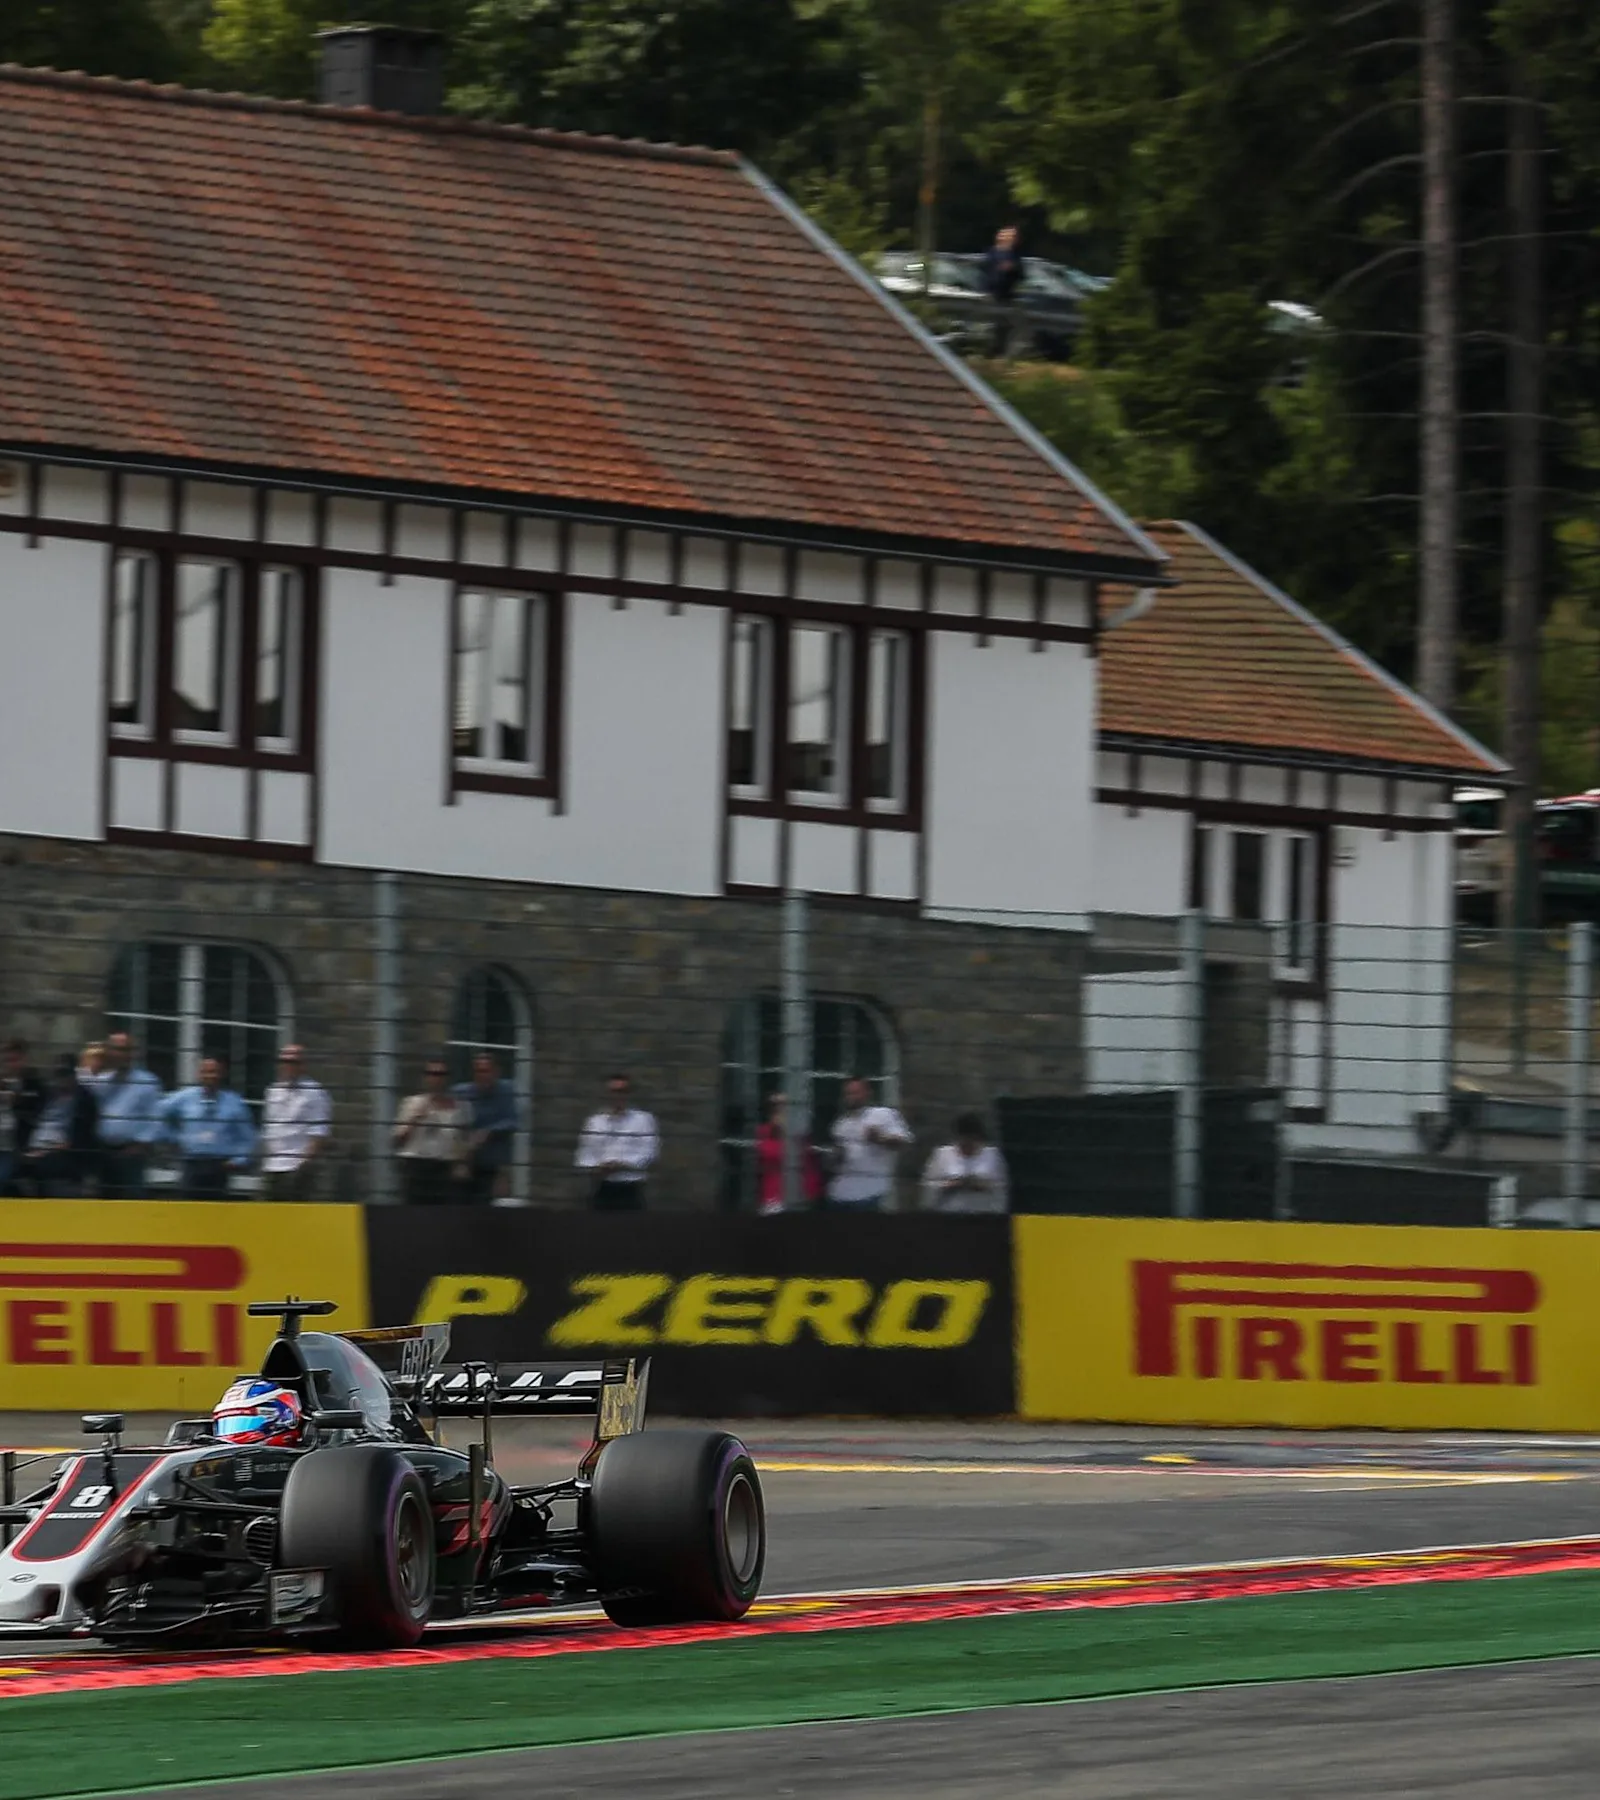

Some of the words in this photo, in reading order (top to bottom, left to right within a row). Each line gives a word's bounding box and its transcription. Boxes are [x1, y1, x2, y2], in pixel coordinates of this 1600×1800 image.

[413, 1274, 527, 1324] P
[544, 1273, 992, 1348] ZERO
[1130, 1260, 1541, 1385] PIRELLI
[69, 1485, 114, 1508] 8
